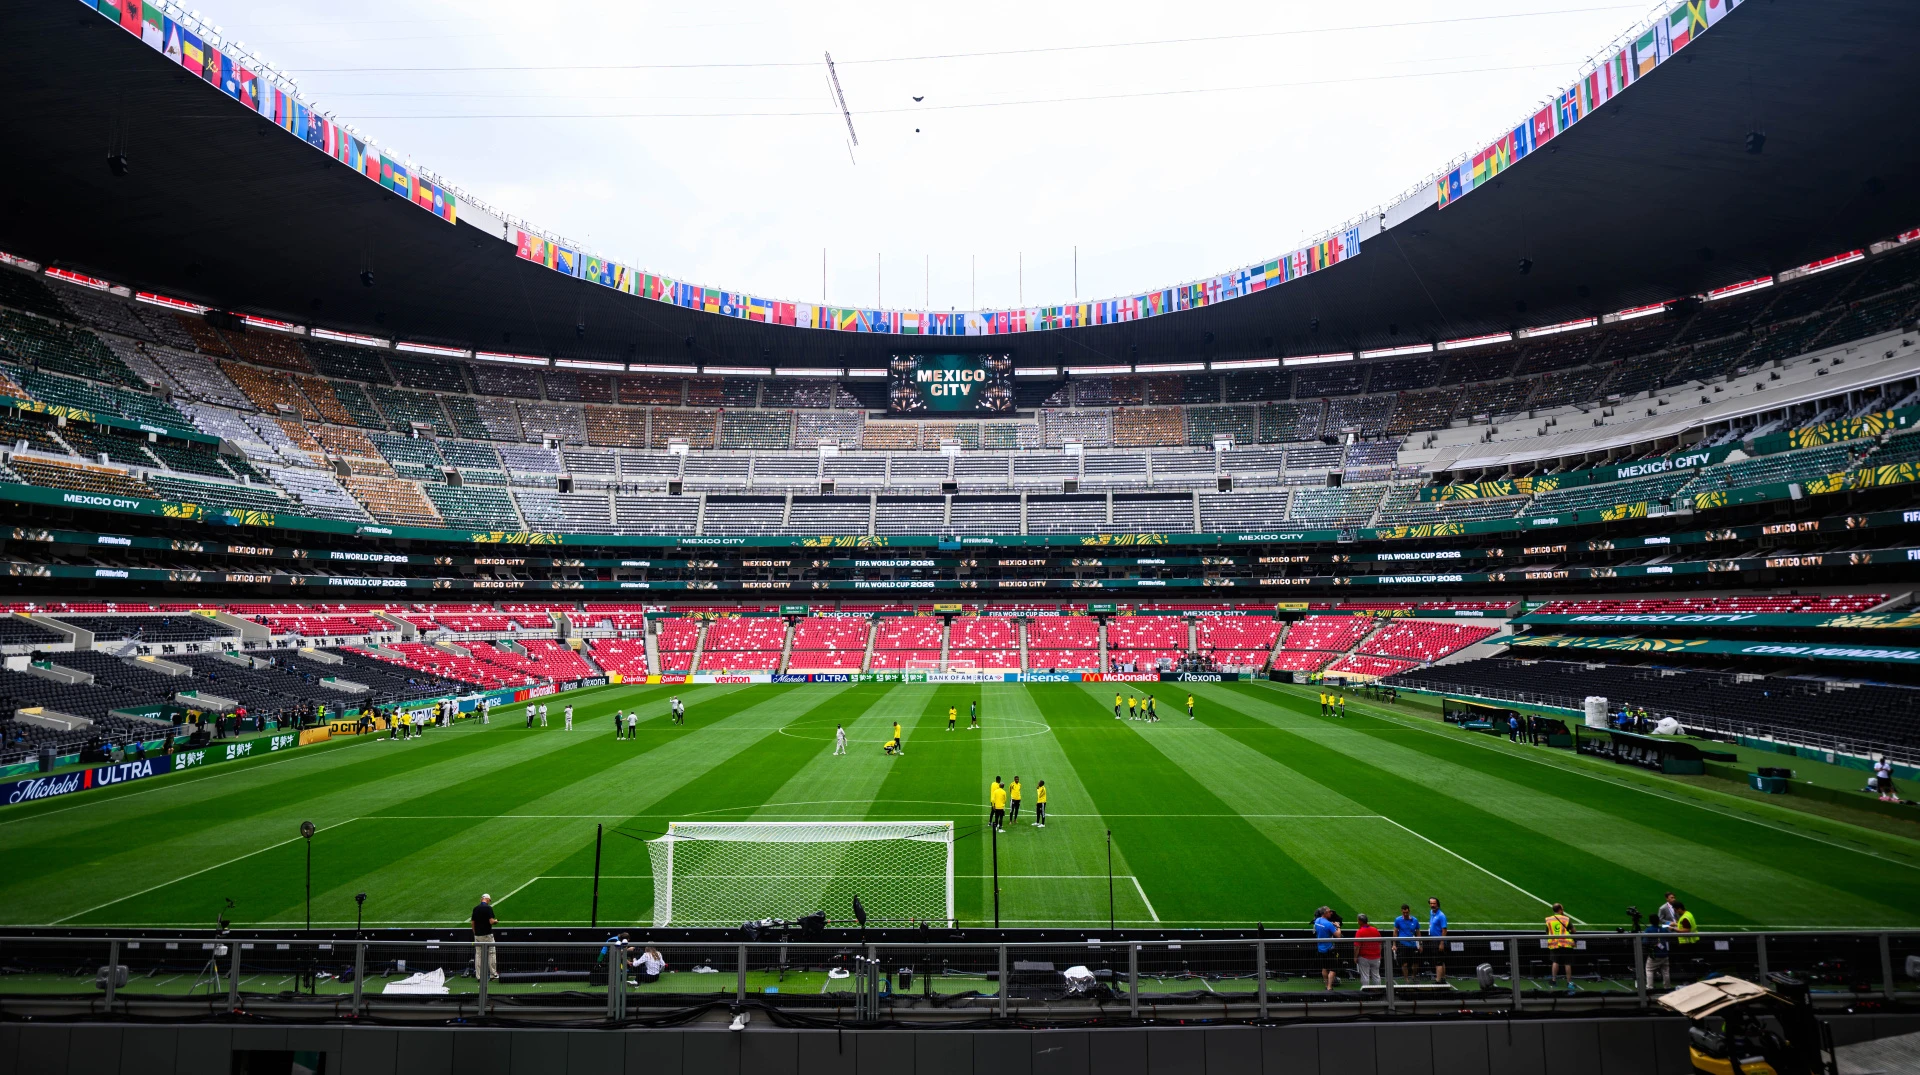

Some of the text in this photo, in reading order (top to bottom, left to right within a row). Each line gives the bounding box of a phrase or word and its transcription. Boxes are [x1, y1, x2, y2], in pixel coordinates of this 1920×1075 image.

[917, 369, 986, 382] MEXICO
[930, 384, 972, 396] CITY
[1618, 452, 1710, 478] MEXICO CITY
[64, 494, 140, 509] MEXICO CITY
[1904, 511, 1920, 522] FIF
[1763, 521, 1819, 535] MEXICO CITY
[228, 546, 274, 556] MEXICO CITY
[1524, 546, 1550, 554] MEXICO
[1908, 550, 1920, 560] FI
[330, 552, 344, 560] FIFA
[344, 552, 369, 561] WORLD
[1766, 556, 1822, 568] MEXICO CITY
[226, 574, 272, 584] MEXICO CITY
[1526, 572, 1552, 580] MEXICO
[342, 578, 368, 586] WORLD
[1742, 646, 1920, 660] COPA MUNDIAL
[584, 678, 606, 686] Rexona
[622, 676, 646, 684] Sabritas
[660, 676, 686, 684] Sabritas
[714, 675, 750, 684] verizon
[772, 674, 806, 683] Michelob
[1017, 672, 1069, 682] Hisense
[1102, 672, 1158, 682] McDonald's
[1184, 672, 1222, 682] Rexona
[529, 684, 556, 698] McDonald's
[564, 682, 578, 690] Rexona
[280, 734, 295, 748] 蒙牛
[236, 742, 253, 757] 蒙牛
[187, 751, 205, 766] 蒙牛
[10, 760, 152, 804] Michelob ULTRA
